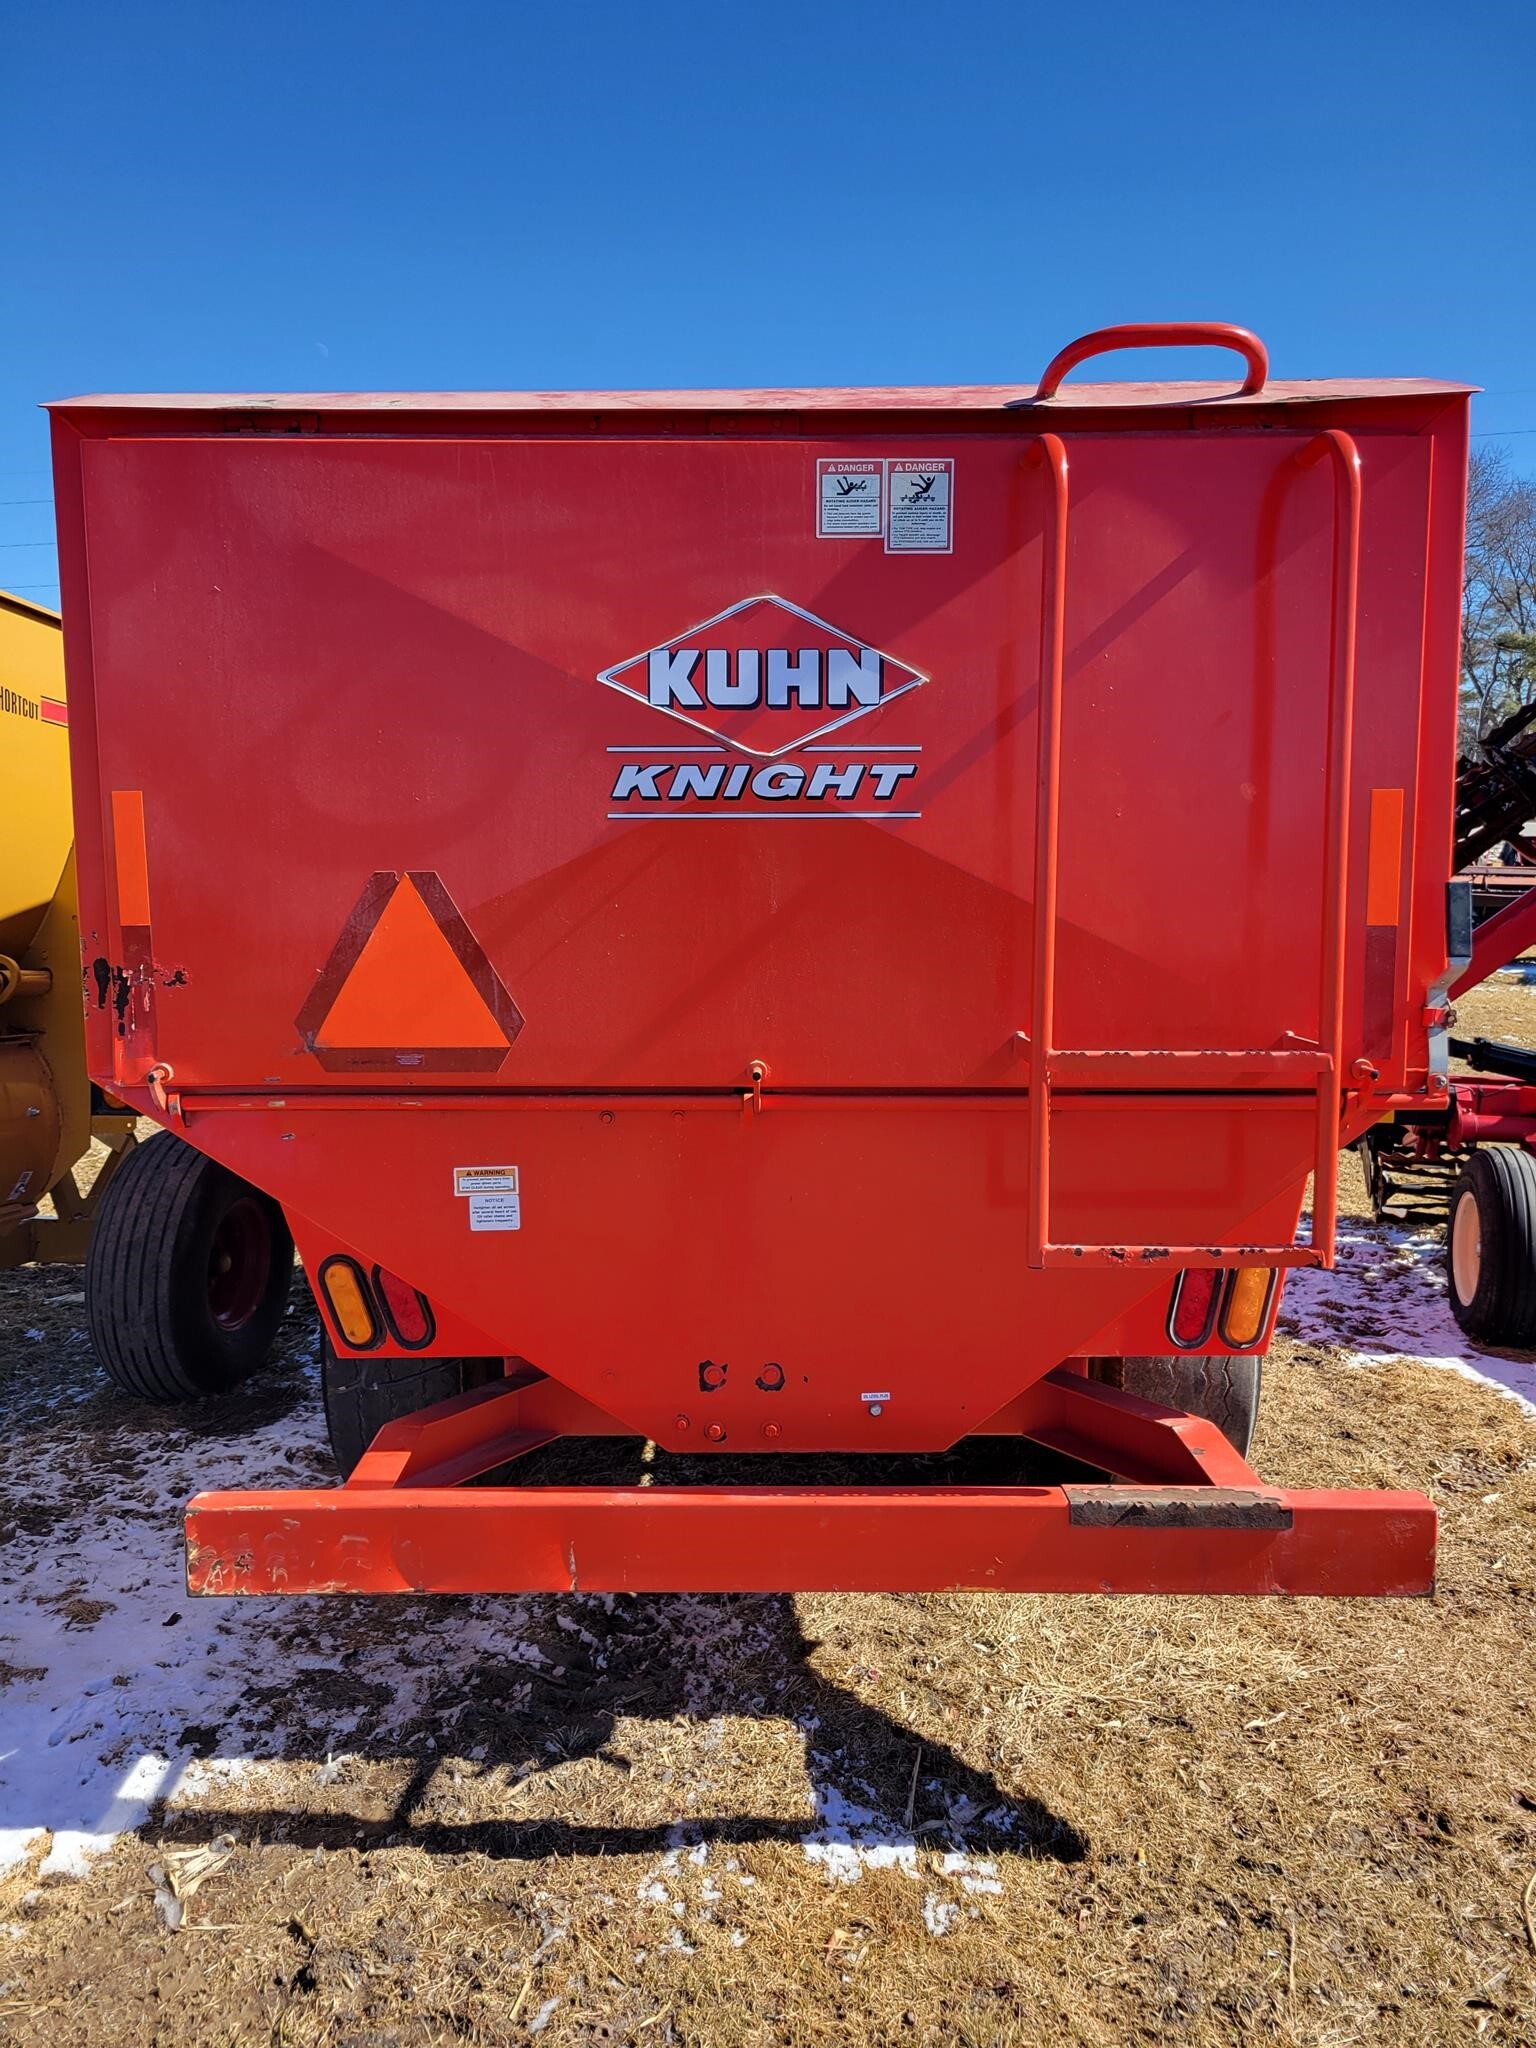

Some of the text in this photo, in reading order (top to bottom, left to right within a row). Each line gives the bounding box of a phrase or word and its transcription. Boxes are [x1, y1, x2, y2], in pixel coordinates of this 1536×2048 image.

[837, 464, 874, 472] DANGER
[905, 463, 945, 472] DANGER
[647, 648, 885, 709] KUHN
[610, 763, 918, 801] KNIGHT
